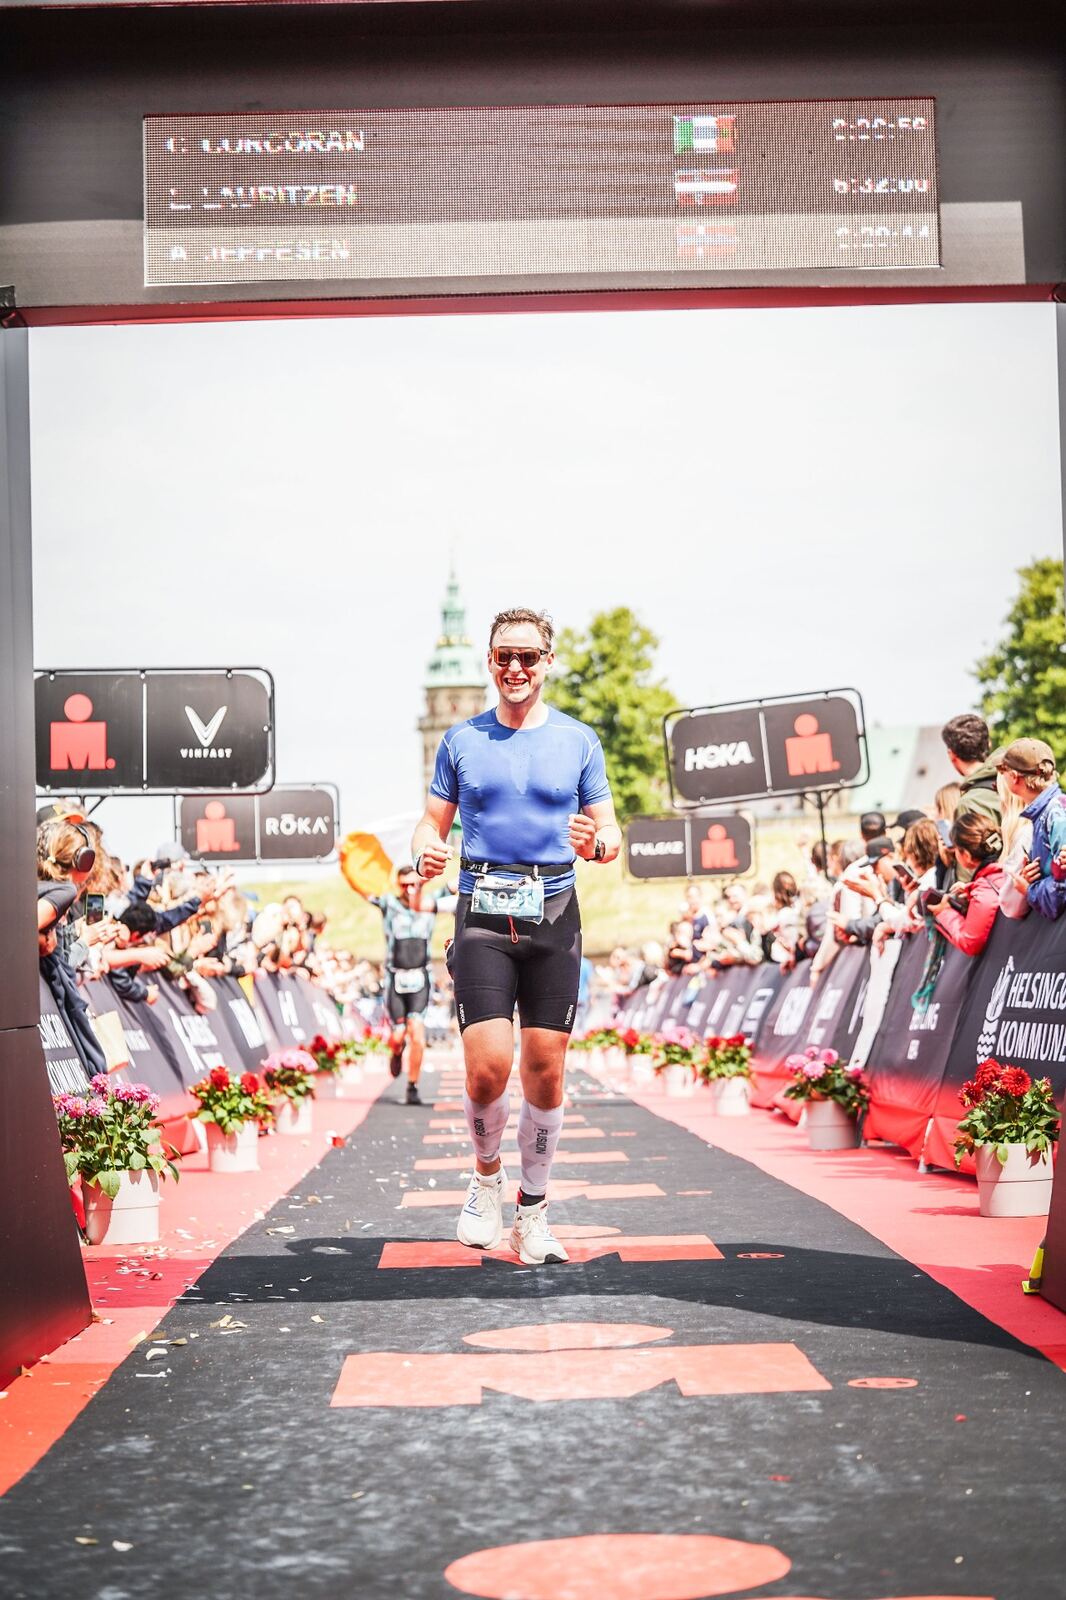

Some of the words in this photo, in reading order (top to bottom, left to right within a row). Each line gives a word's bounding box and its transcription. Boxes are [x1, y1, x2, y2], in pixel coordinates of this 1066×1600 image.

[180, 747, 233, 759] VINFAST
[684, 741, 753, 772] HOKA
[564, 1004, 574, 1025] FUSION
[535, 1127, 548, 1155] FUSION
